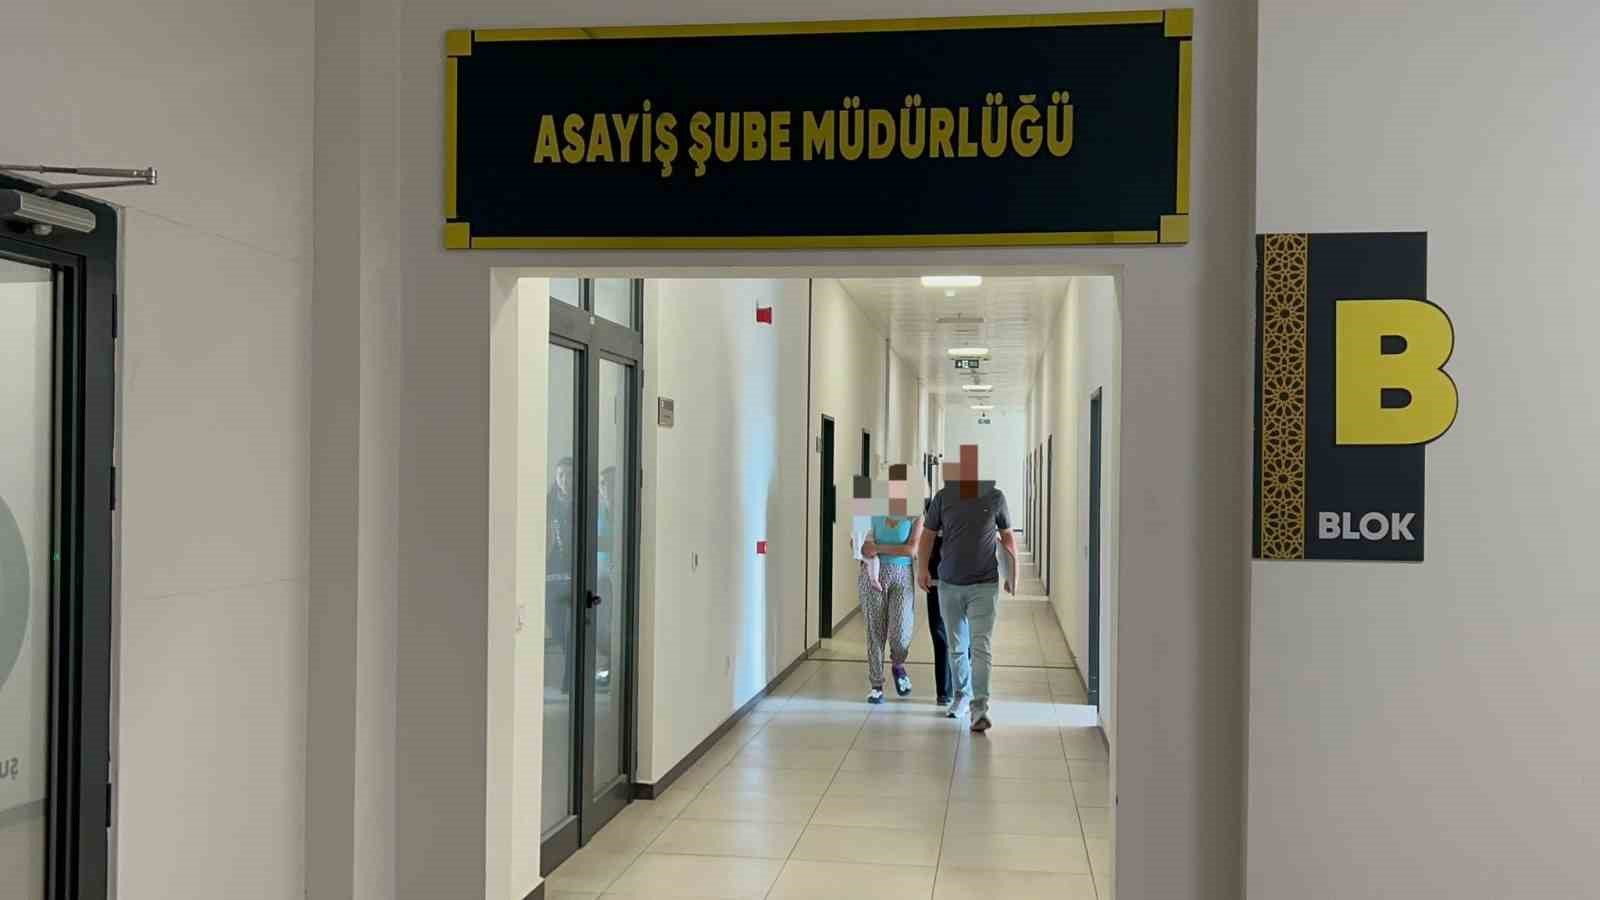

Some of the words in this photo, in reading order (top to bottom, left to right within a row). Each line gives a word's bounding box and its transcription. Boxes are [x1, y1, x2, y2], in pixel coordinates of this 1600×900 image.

[533, 99, 678, 178] ASAYİŞ
[688, 111, 792, 177] ŞUBE
[802, 91, 1074, 160] MÜDÜRLÜĞÜ
[1335, 299, 1458, 446] B
[1318, 511, 1415, 540] BLOK
